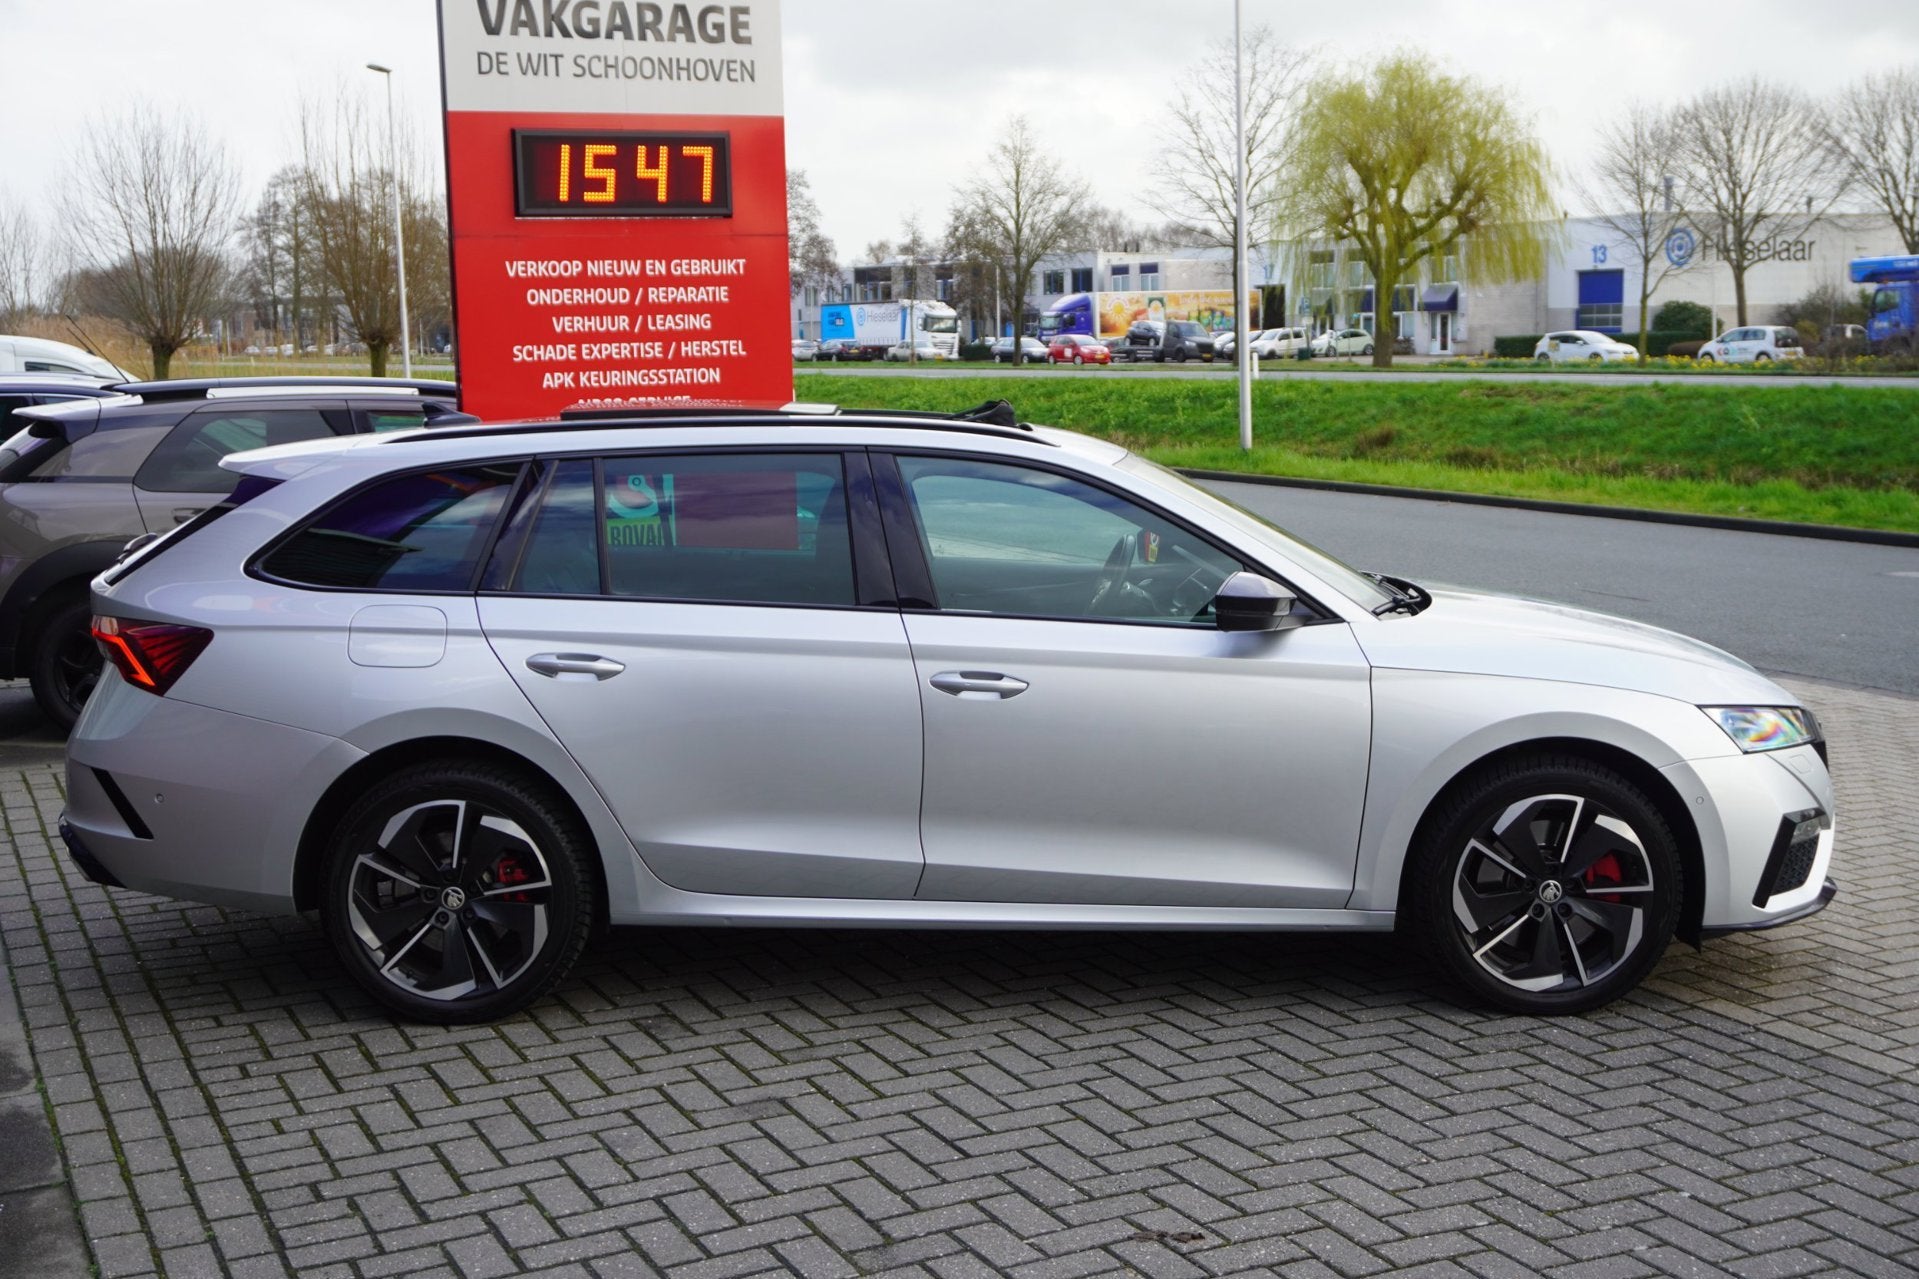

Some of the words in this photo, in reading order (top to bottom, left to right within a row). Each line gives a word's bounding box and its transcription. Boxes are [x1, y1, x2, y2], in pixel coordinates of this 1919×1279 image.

[476, 0, 752, 45] VAKGARAGE
[477, 51, 509, 76] DE
[516, 52, 564, 77] WIT
[572, 54, 756, 83] SCHOONHOVEN
[1592, 244, 1607, 264] 13
[505, 260, 582, 278] VERKOOP
[587, 259, 641, 276] NIEUW
[645, 259, 666, 275] EN
[671, 258, 746, 276] GEBRUIKT
[526, 288, 630, 306] ONDERHOUD
[635, 287, 643, 305] /
[648, 286, 729, 303] REPARATIE
[552, 315, 629, 333] VERHUUR
[634, 315, 643, 333] /
[647, 313, 712, 330] LEASING
[512, 344, 576, 362] SCHADE
[581, 342, 663, 359] EXPERTISE
[667, 341, 676, 359] /
[681, 340, 747, 356] HERSTEL
[542, 371, 575, 388] APK
[579, 367, 721, 388] KEURINGSSTATION
